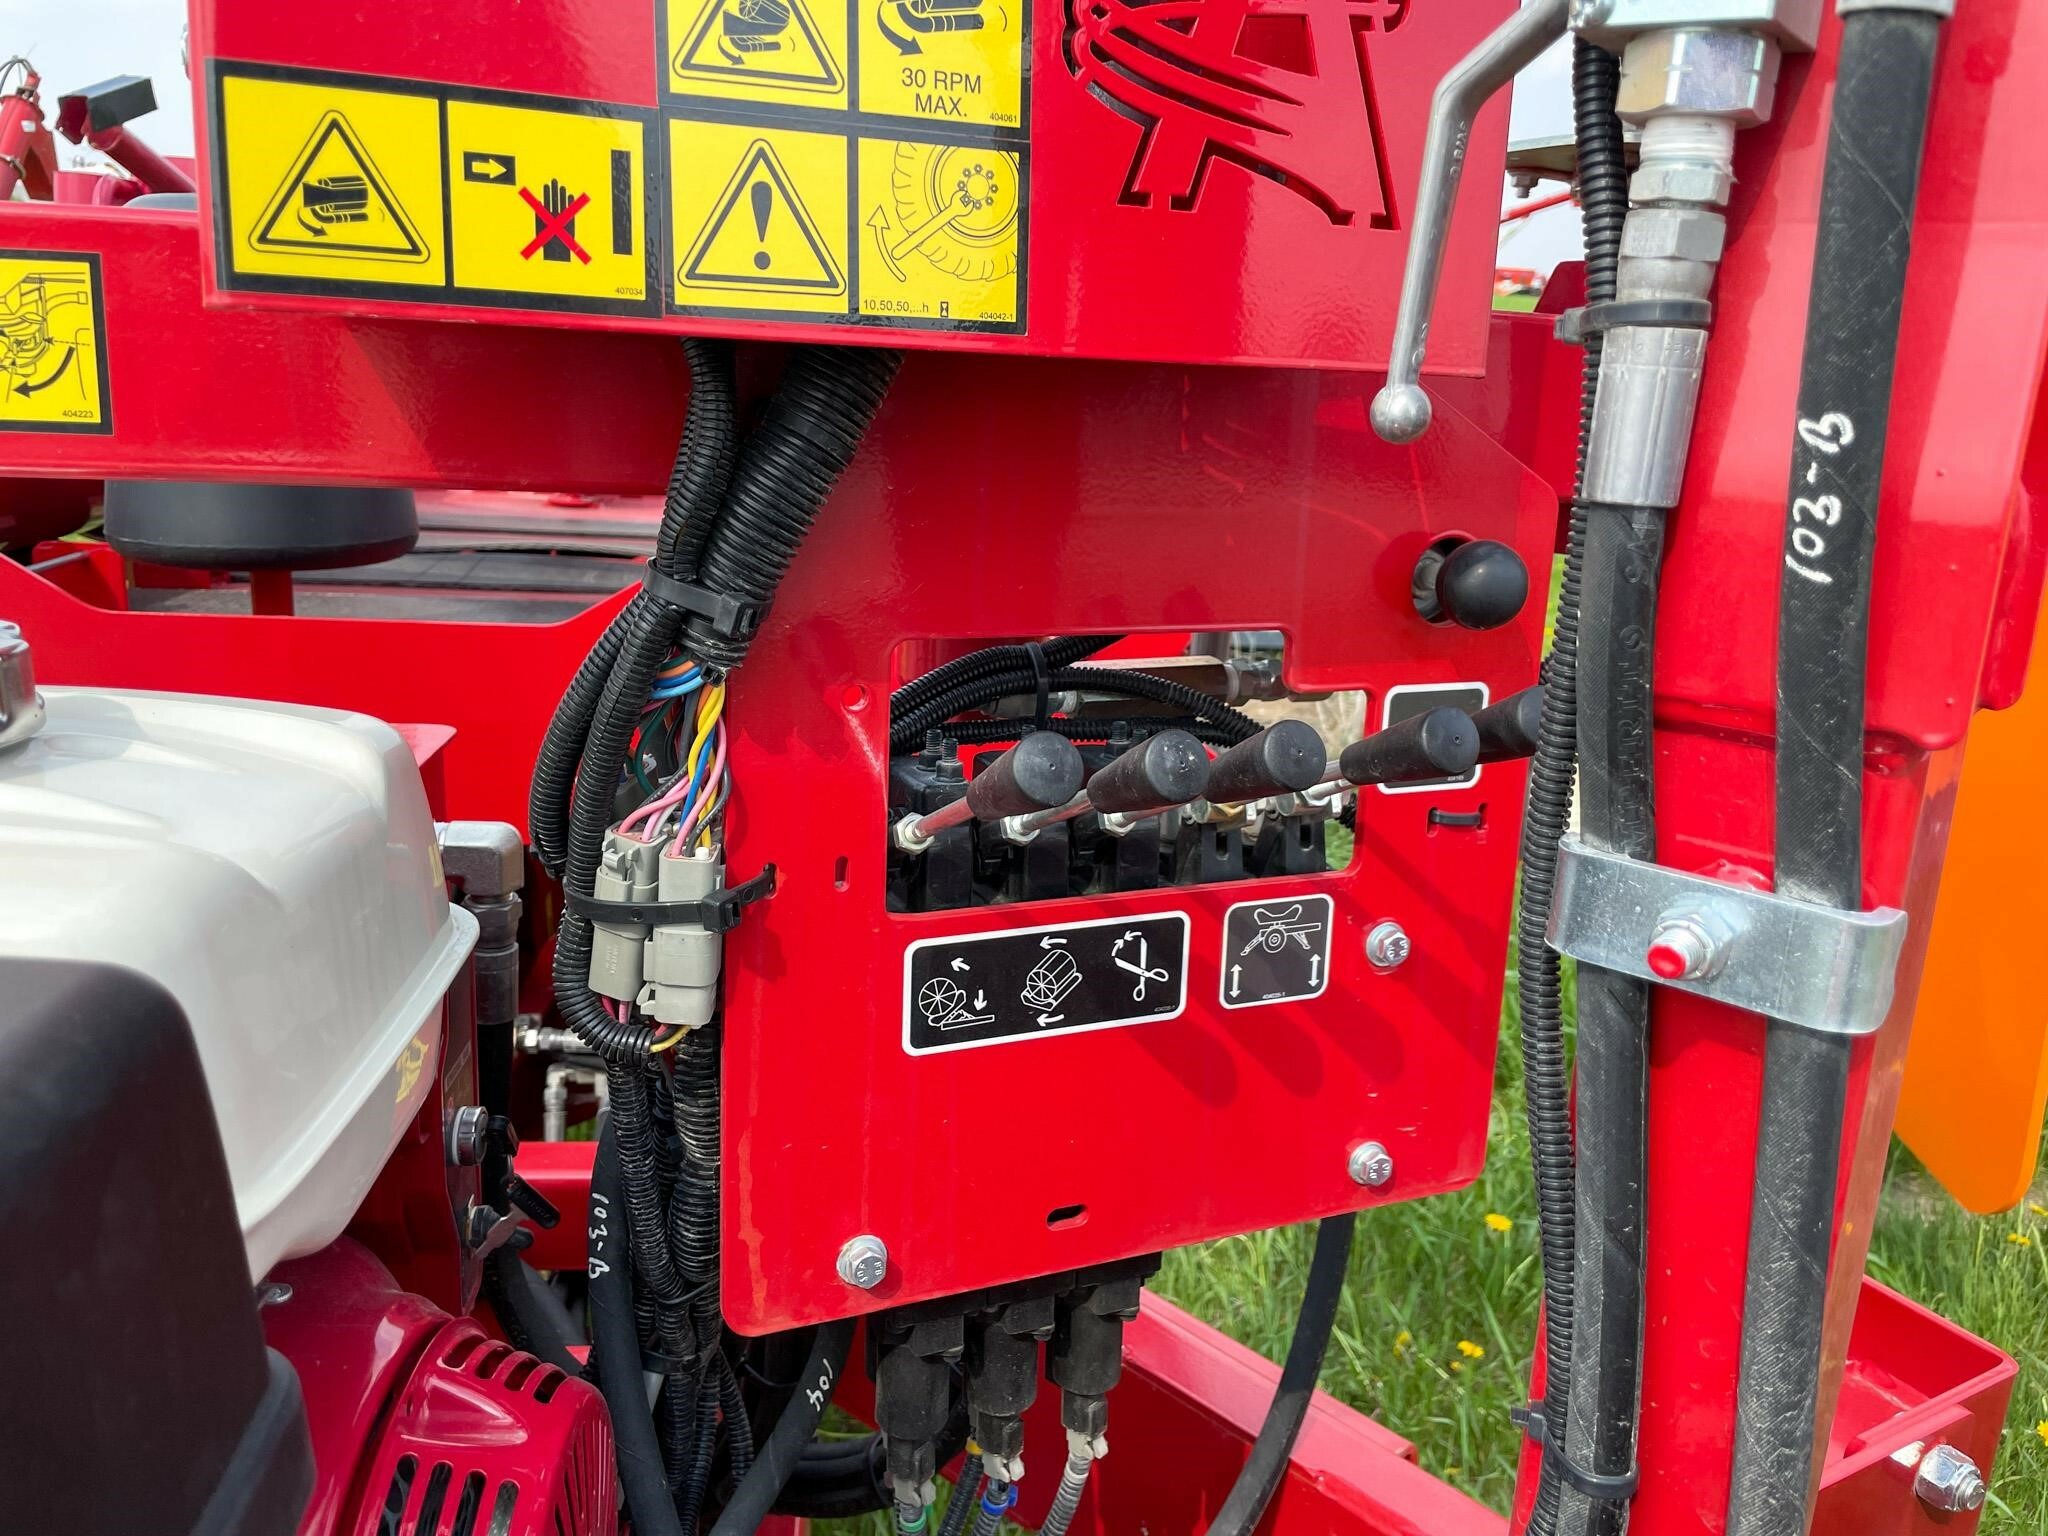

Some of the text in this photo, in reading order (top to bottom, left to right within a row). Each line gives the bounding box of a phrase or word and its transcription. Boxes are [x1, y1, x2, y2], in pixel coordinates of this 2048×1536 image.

[901, 67, 981, 94] 30 RPM
[915, 93, 968, 117] MAX.
[989, 112, 1017, 123] 404061
[614, 286, 643, 296] 407034
[978, 311, 1013, 321] 404042-1
[62, 409, 93, 418] 404223
[1784, 412, 1855, 584] 103-B
[588, 1192, 611, 1279] 103-B
[805, 1357, 833, 1412] 104
